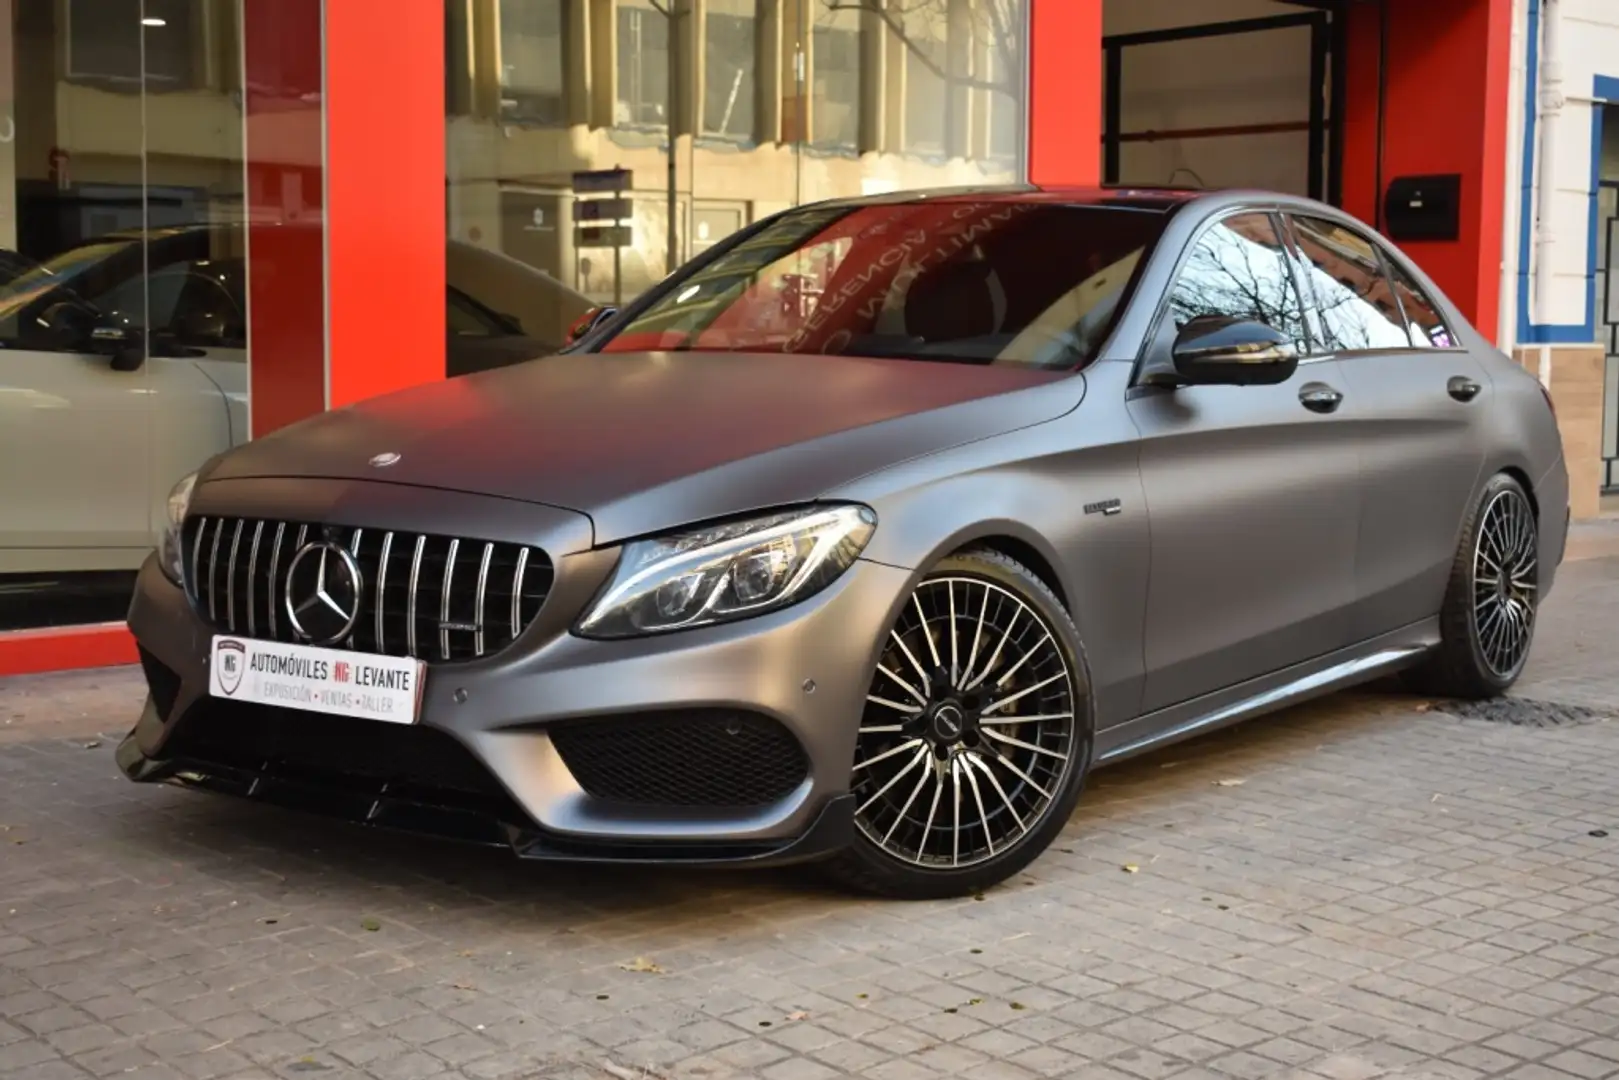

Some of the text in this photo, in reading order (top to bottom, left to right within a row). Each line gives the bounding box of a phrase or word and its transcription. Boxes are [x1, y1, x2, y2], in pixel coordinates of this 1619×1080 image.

[250, 652, 410, 691] AUTOMÓVILES NG LEVANTE
[320, 688, 353, 709] VENTAS
[361, 693, 394, 713] TALLER
